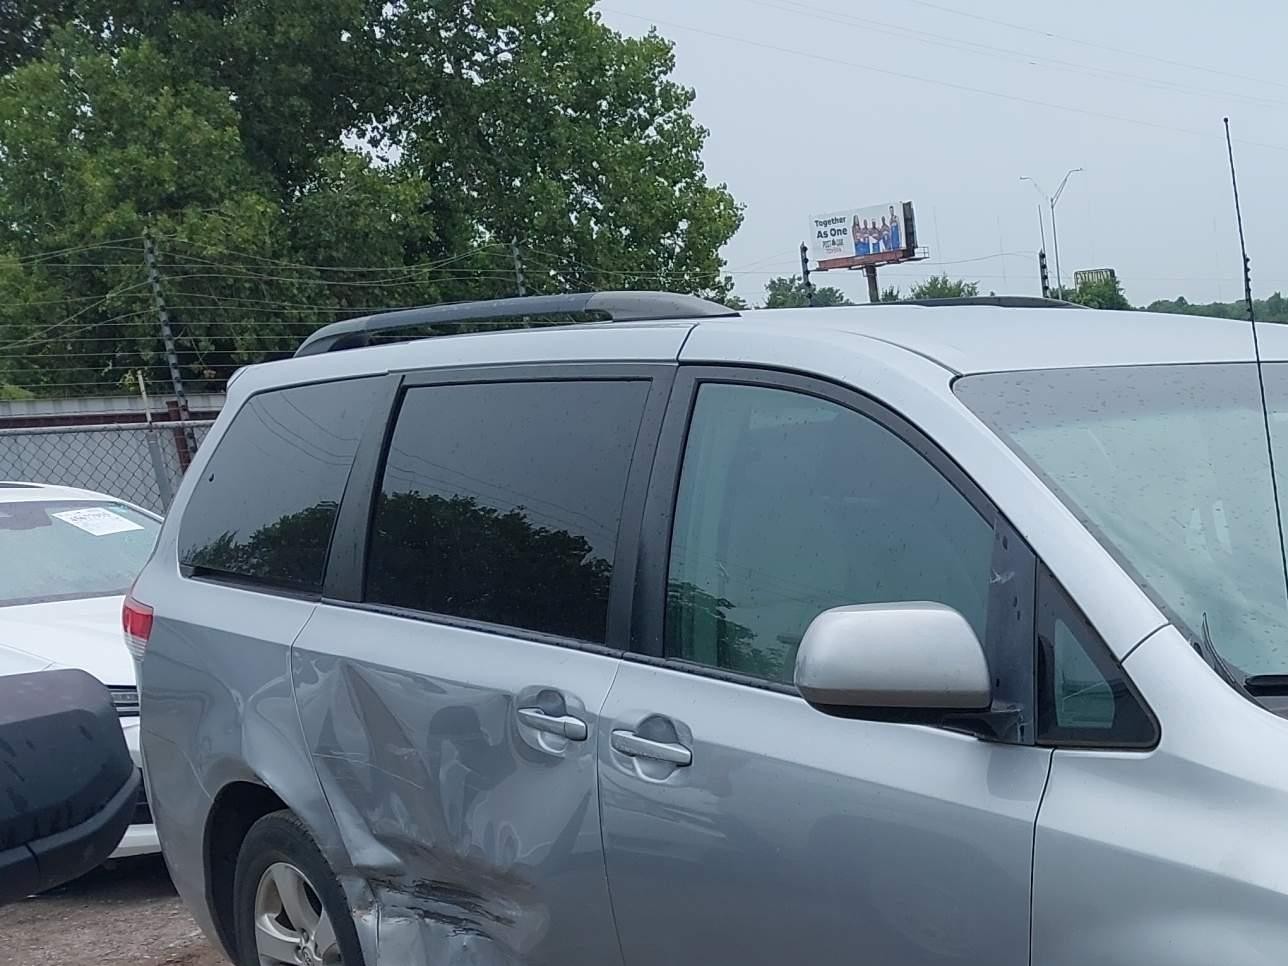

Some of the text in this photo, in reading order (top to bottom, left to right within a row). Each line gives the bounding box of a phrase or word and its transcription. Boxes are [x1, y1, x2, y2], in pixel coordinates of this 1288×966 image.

[814, 216, 846, 227] Together
[817, 227, 847, 238] As One
